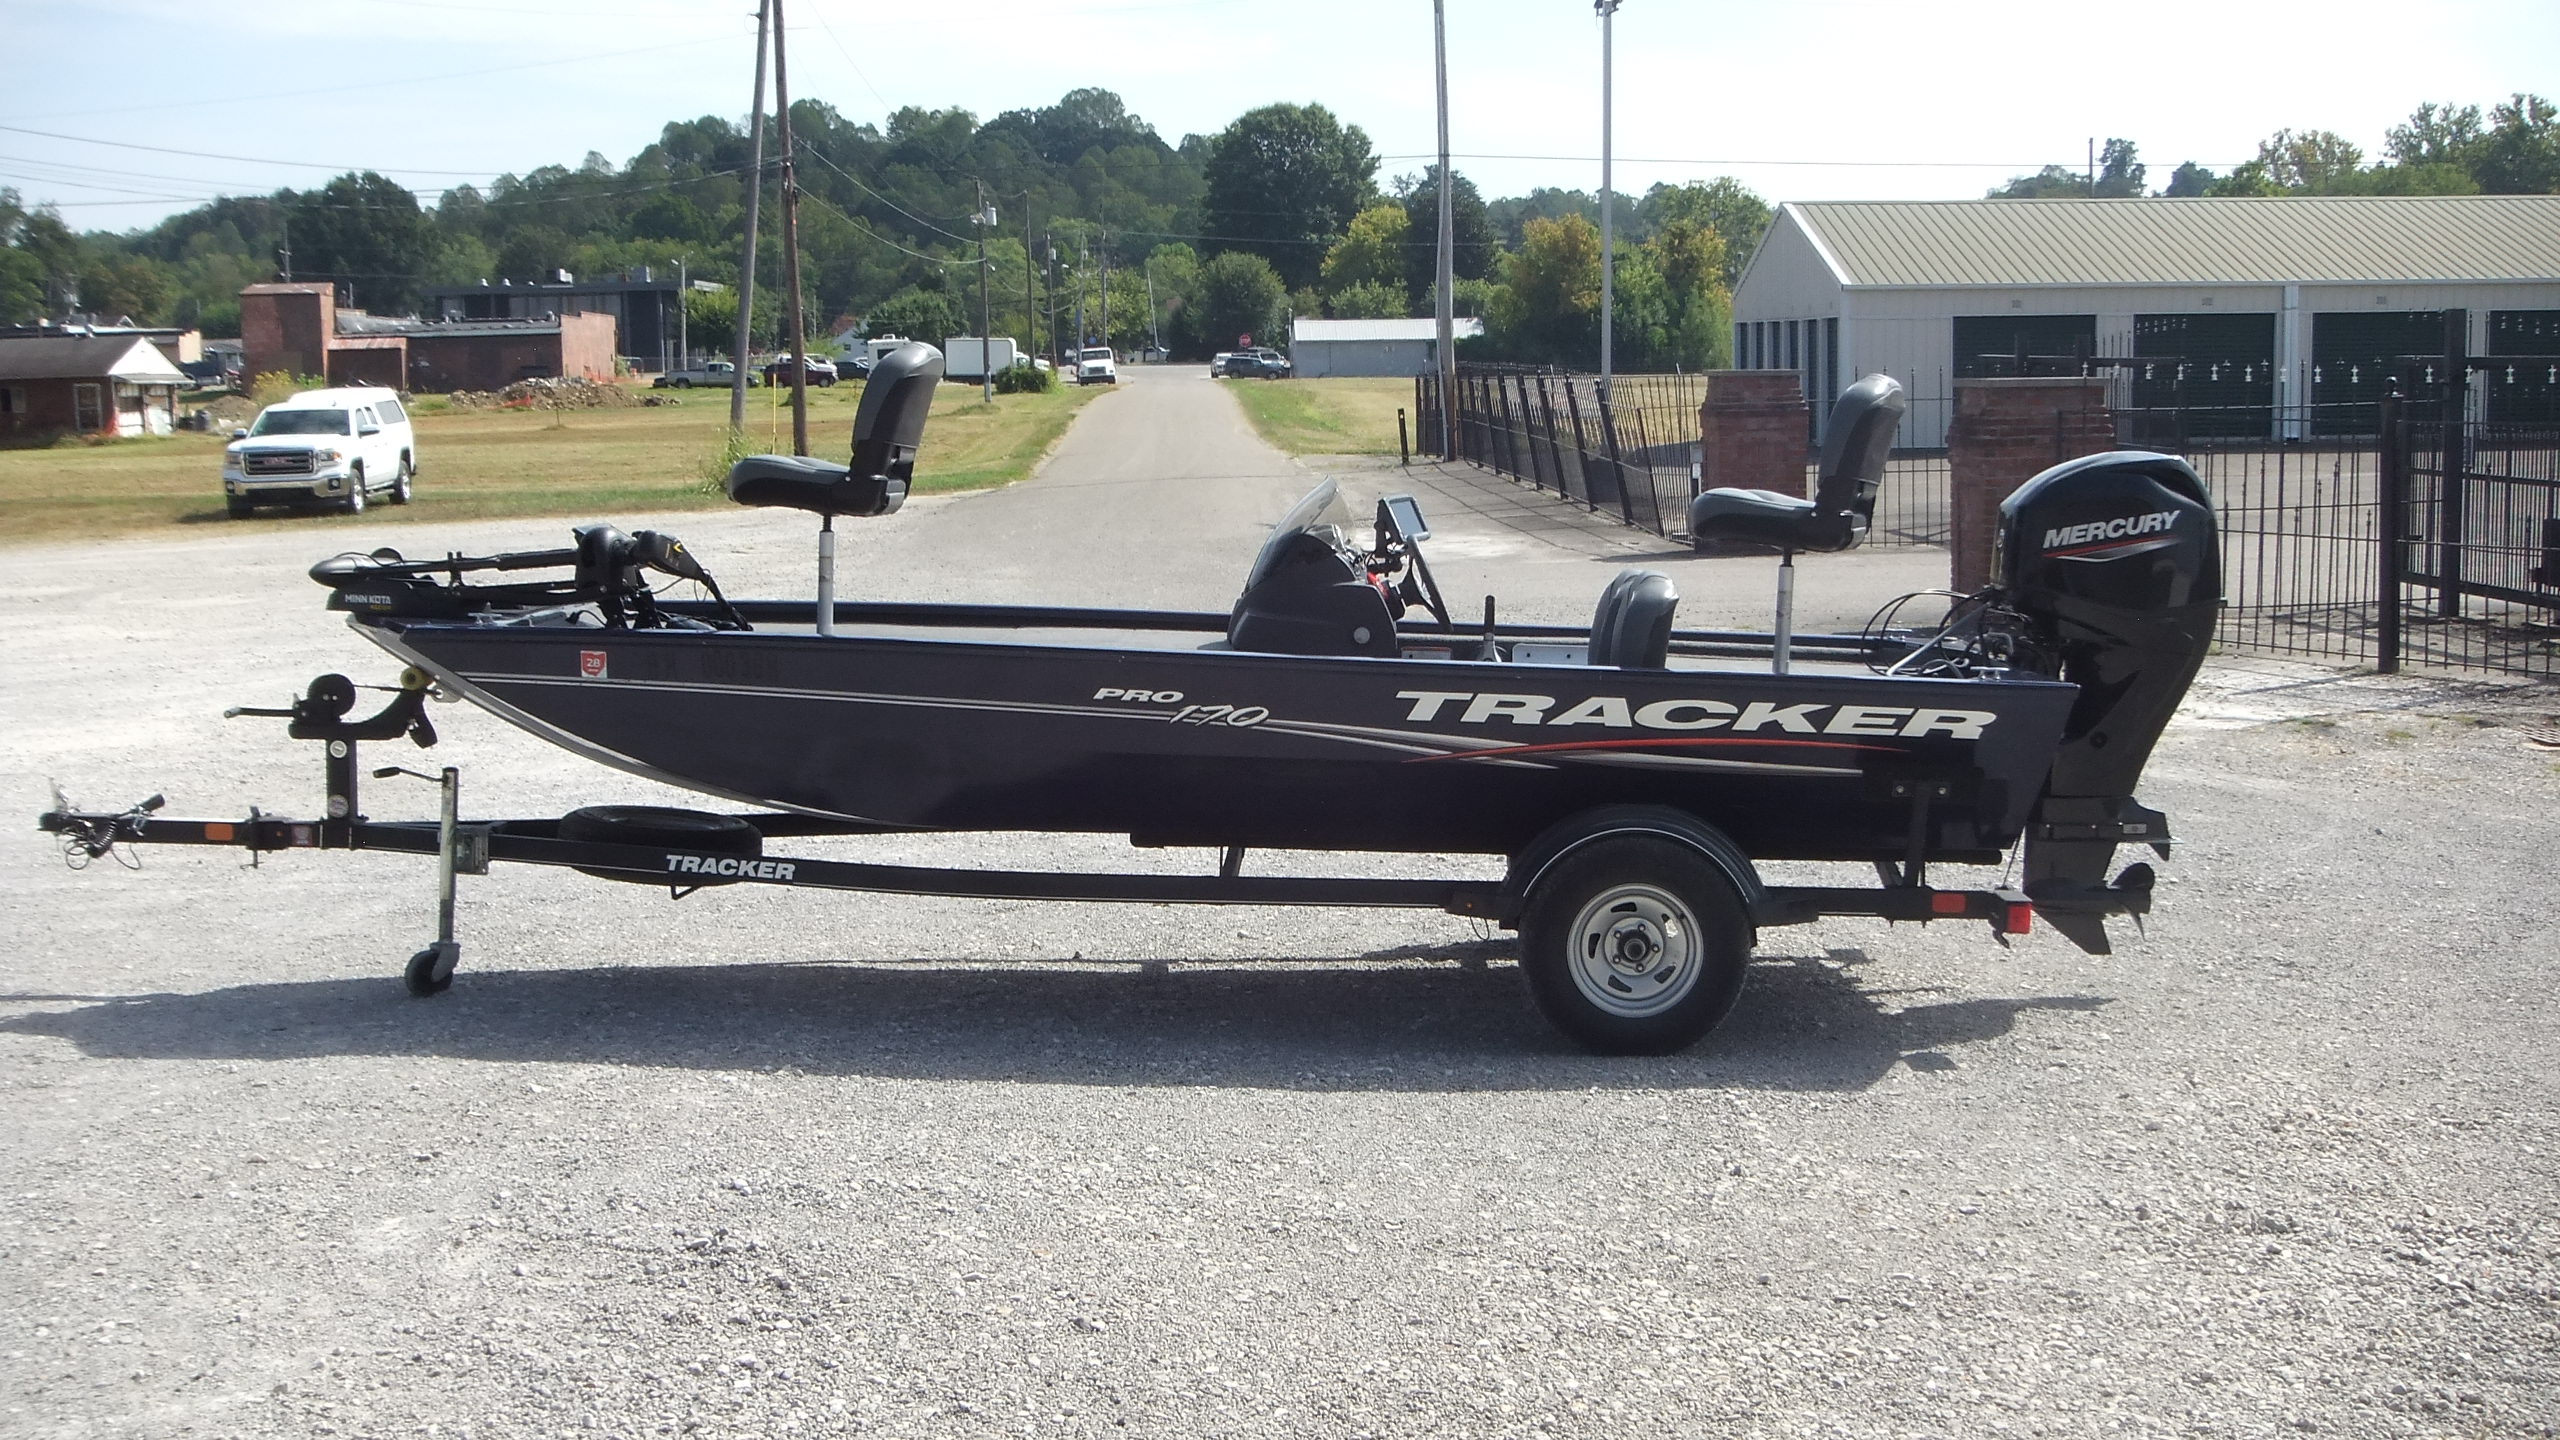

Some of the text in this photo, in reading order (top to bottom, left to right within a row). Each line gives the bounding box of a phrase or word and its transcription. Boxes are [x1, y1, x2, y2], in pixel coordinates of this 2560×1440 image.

[2042, 509, 2181, 549] MERCURY
[344, 593, 391, 605] MINN KOTA
[1093, 687, 1185, 704] PRO
[1169, 704, 1270, 727] 170
[1396, 690, 1998, 741] TRACKER
[665, 854, 796, 881] TRACKER
